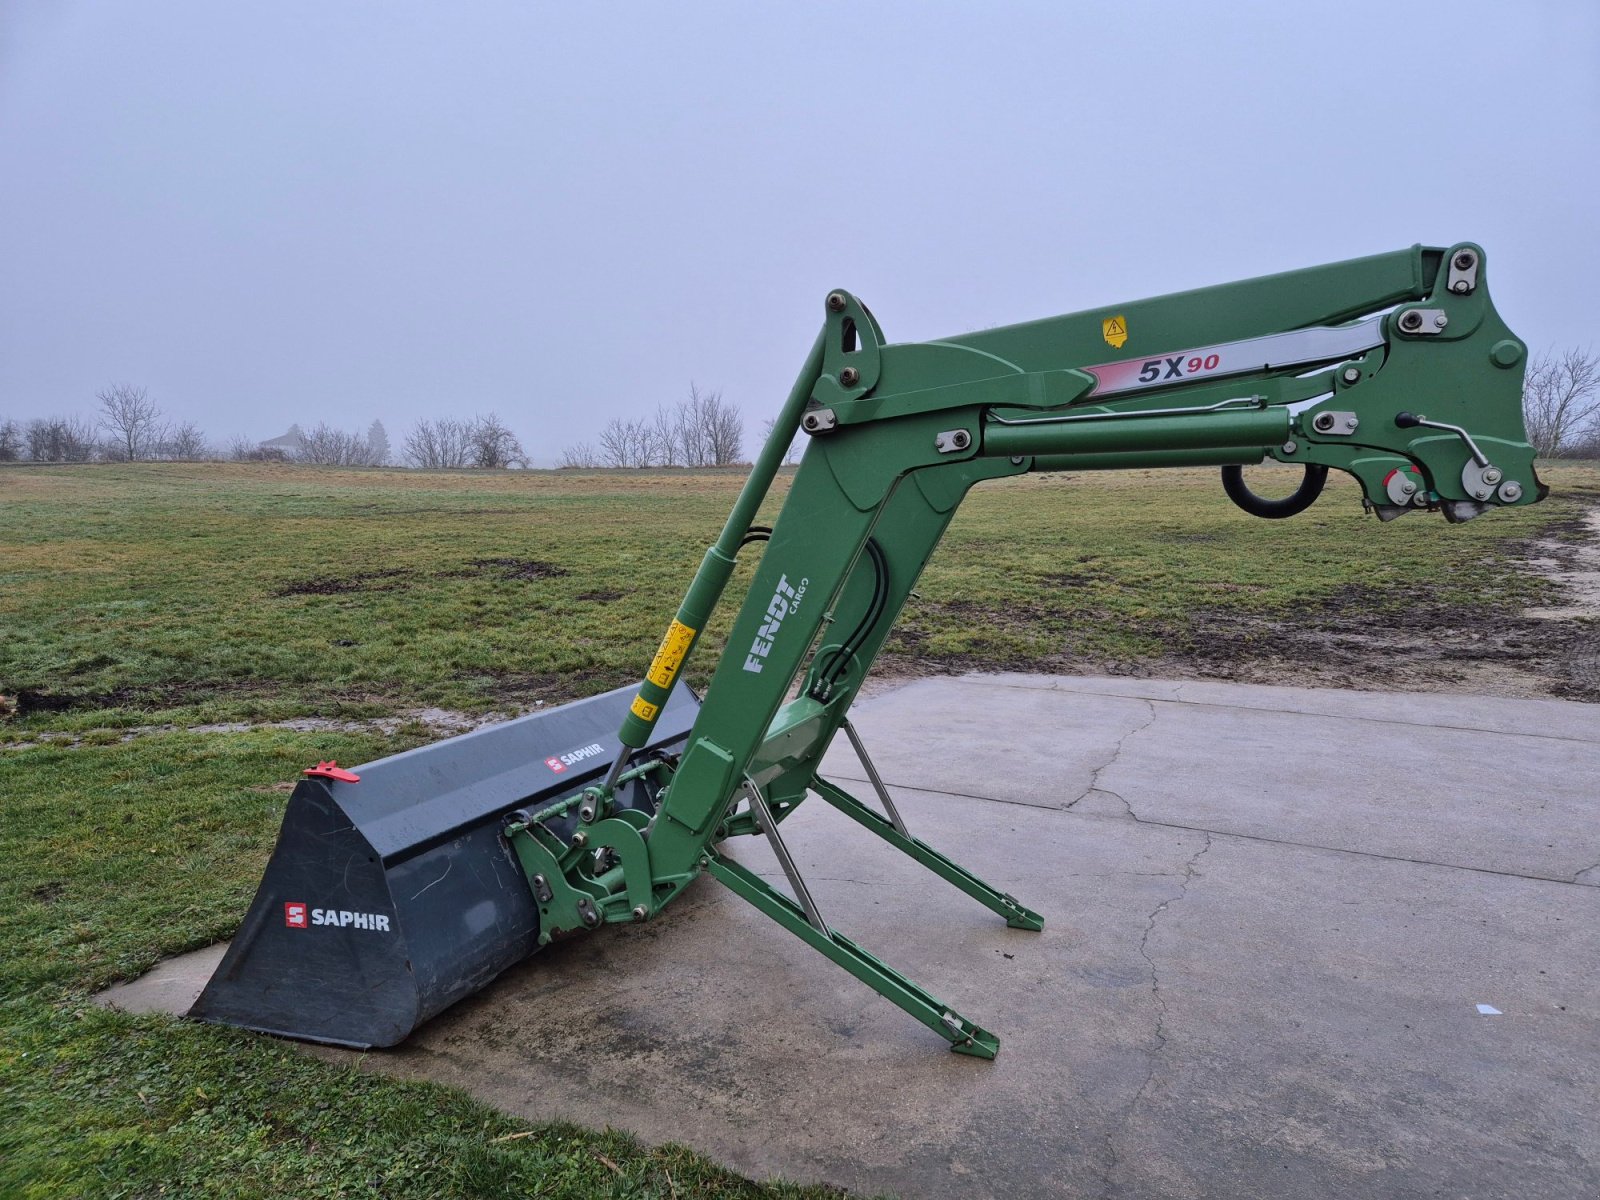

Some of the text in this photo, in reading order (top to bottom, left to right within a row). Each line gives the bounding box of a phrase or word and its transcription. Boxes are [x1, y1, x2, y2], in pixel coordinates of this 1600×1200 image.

[1138, 354, 1220, 383] 5X90
[789, 578, 809, 615] CARGO
[743, 573, 796, 674] FENDT
[560, 743, 605, 766] SAPHIR
[311, 908, 390, 932] SAPHIR
